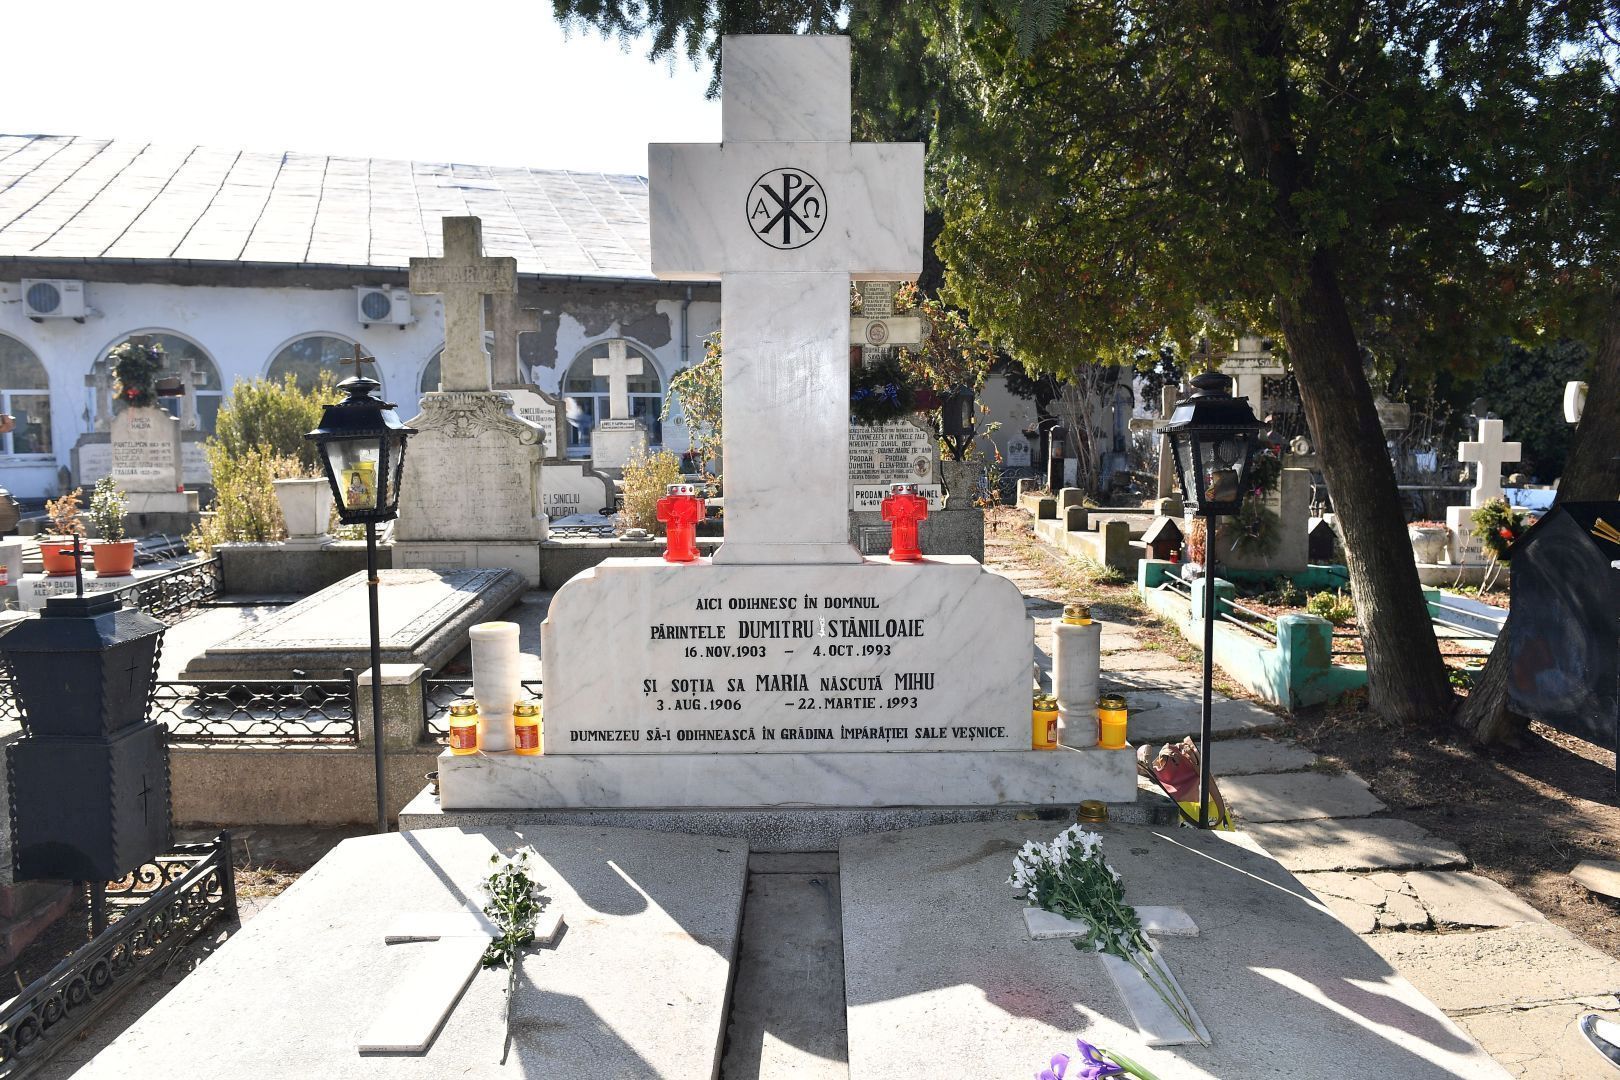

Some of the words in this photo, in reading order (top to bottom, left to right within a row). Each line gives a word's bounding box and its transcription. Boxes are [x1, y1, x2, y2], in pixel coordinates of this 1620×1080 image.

[695, 598, 723, 610] AICI
[728, 597, 797, 610] ODIHNESC
[803, 593, 818, 609] ÎN
[824, 597, 880, 609] DOMNUL
[650, 623, 726, 640] PĂRINTELE
[738, 619, 814, 639] DUMITRU
[827, 616, 925, 638] STĂNILOAIE
[643, 678, 658, 697] ȘI
[671, 678, 715, 697] SOȚIA
[727, 678, 746, 693] SA
[755, 673, 810, 692] MARIA
[820, 675, 884, 692] NĂSCUTĂ
[894, 672, 935, 691] MIHU
[569, 729, 640, 742] DUMNEZEU
[676, 727, 756, 741] ODIHNEASCĂ
[762, 725, 776, 740] ÎN
[780, 726, 835, 740] GRĂDINA
[914, 726, 948, 739] SALE
